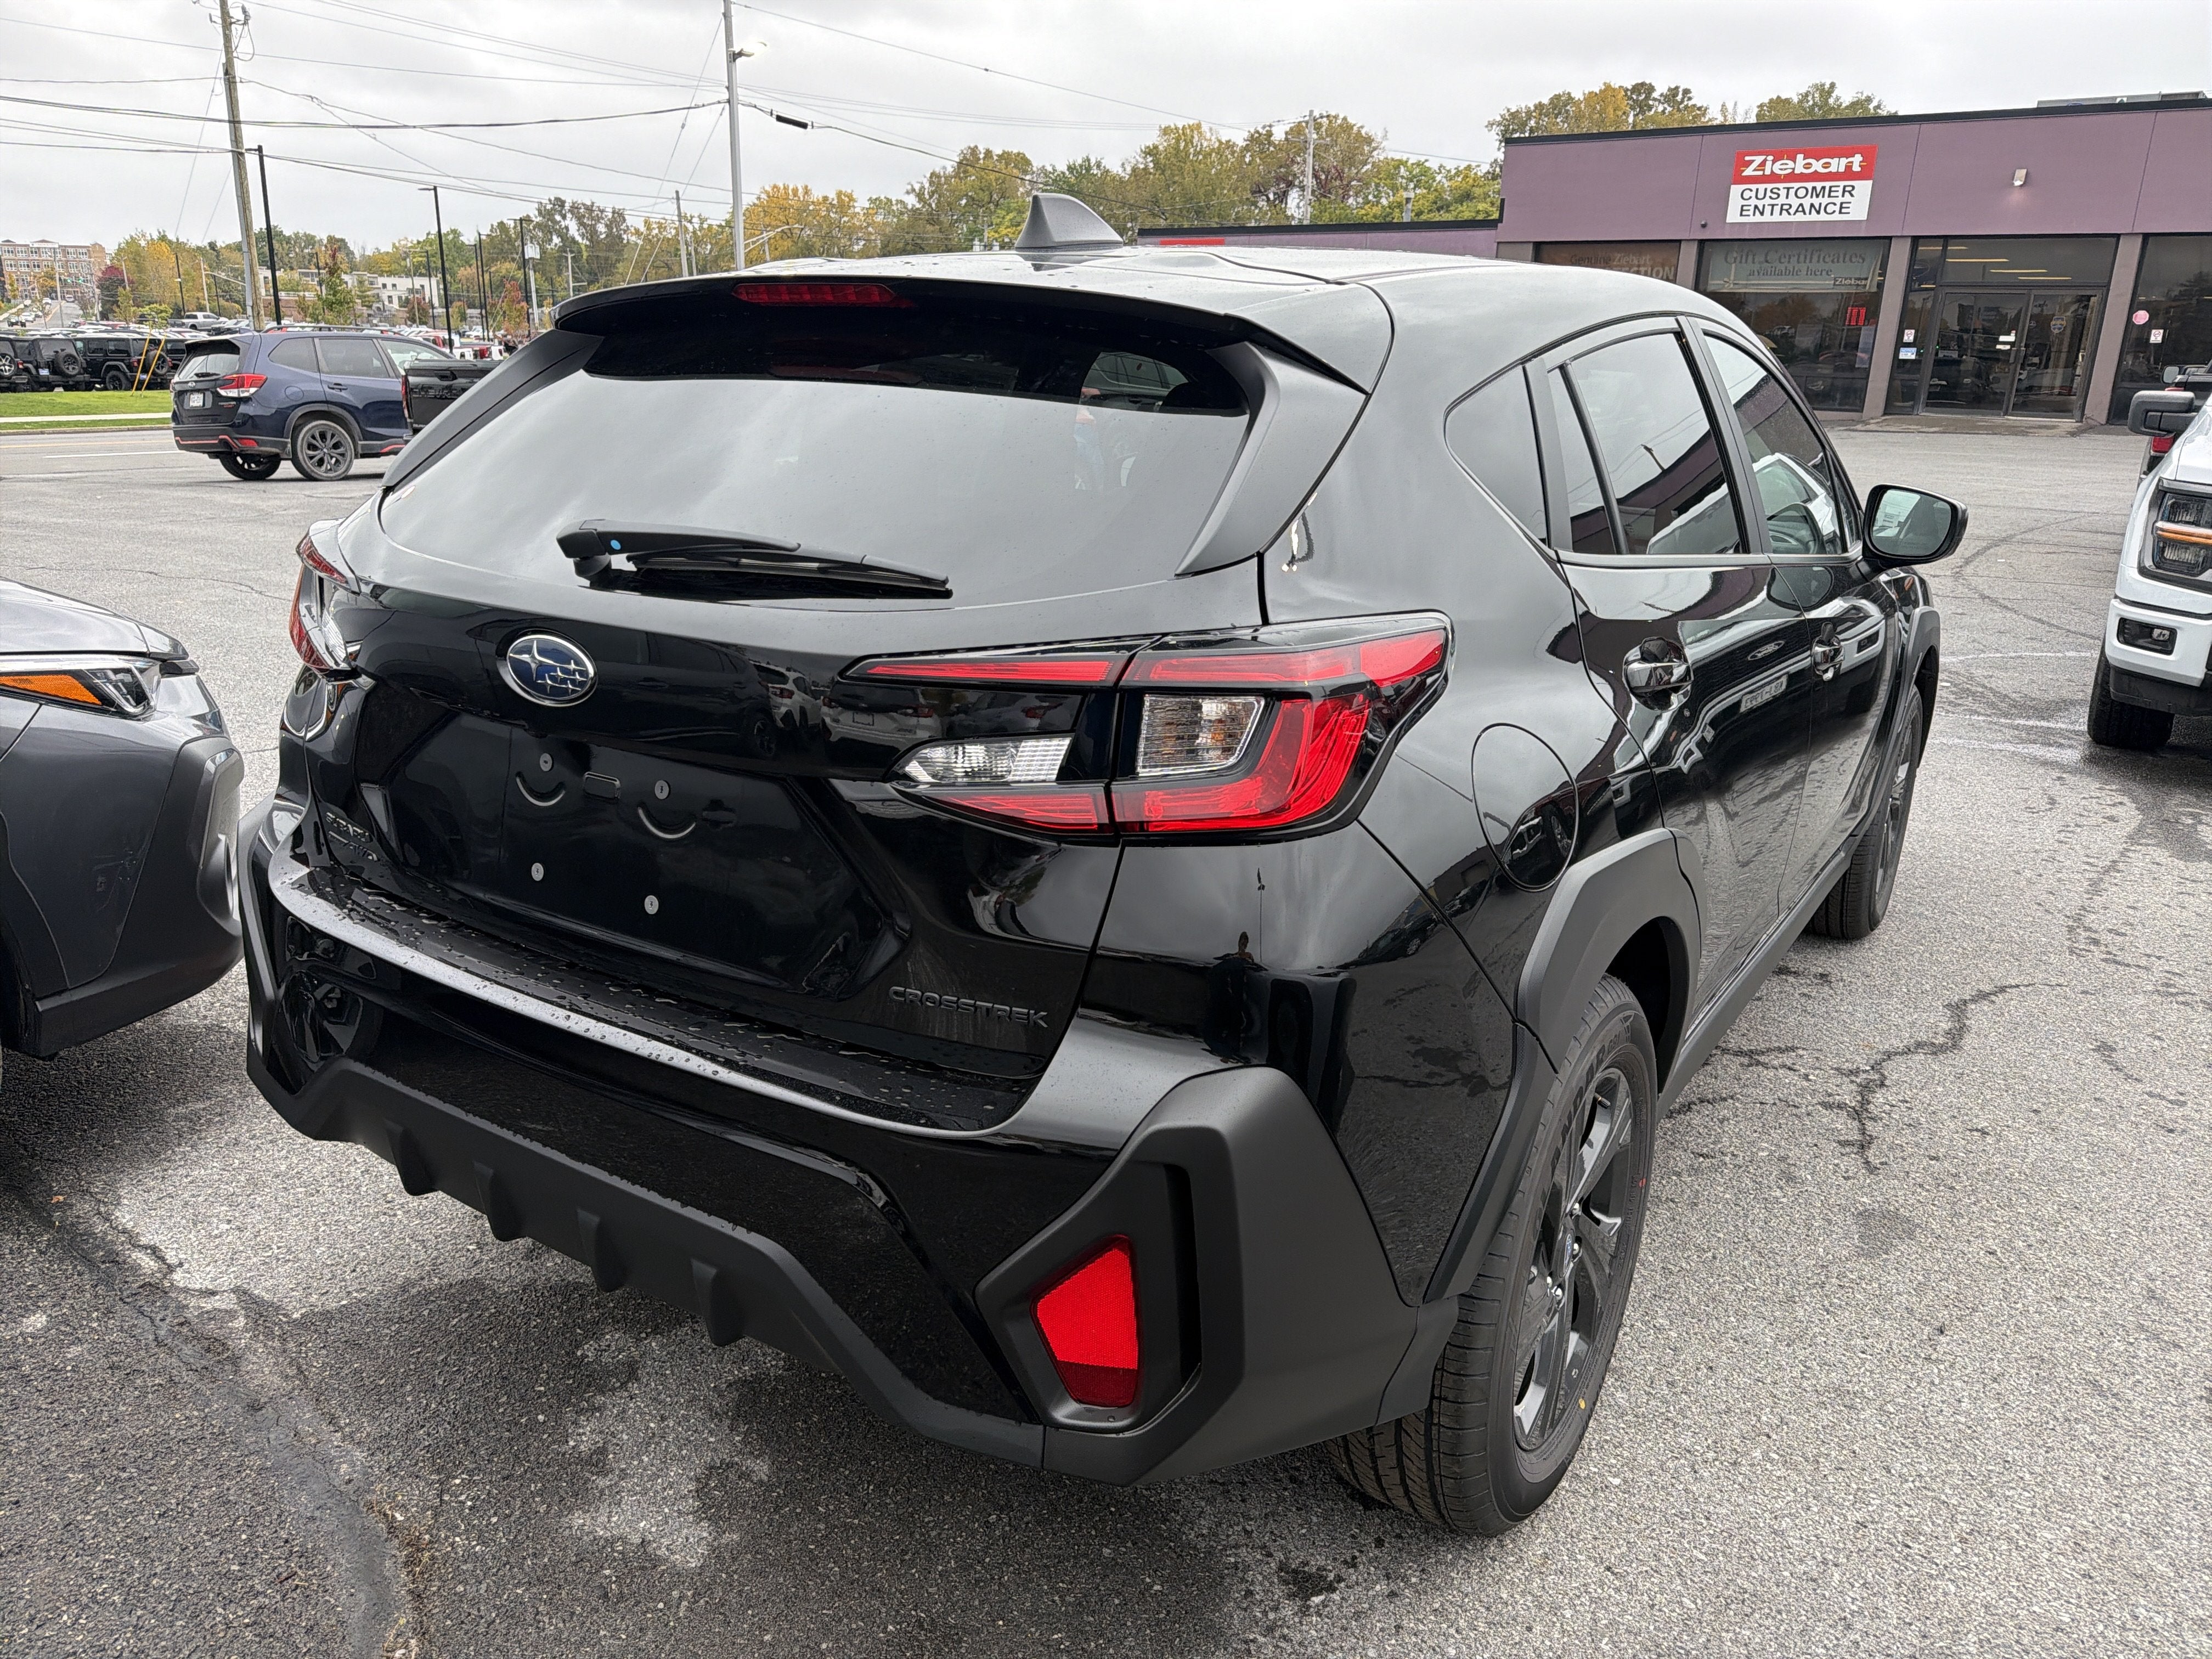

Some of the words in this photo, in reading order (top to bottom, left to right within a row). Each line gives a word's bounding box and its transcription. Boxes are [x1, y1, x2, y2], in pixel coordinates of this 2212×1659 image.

[1741, 154, 1863, 176] Ziebart
[1740, 185, 1855, 200] CUSTOMER
[1740, 202, 1852, 217] ENTRANCE
[1724, 248, 1756, 264] Gift
[1760, 247, 1865, 264] Certificates
[1748, 266, 1802, 277] available
[1806, 266, 1832, 276] here
[889, 986, 1048, 1028] CROSSTREK
